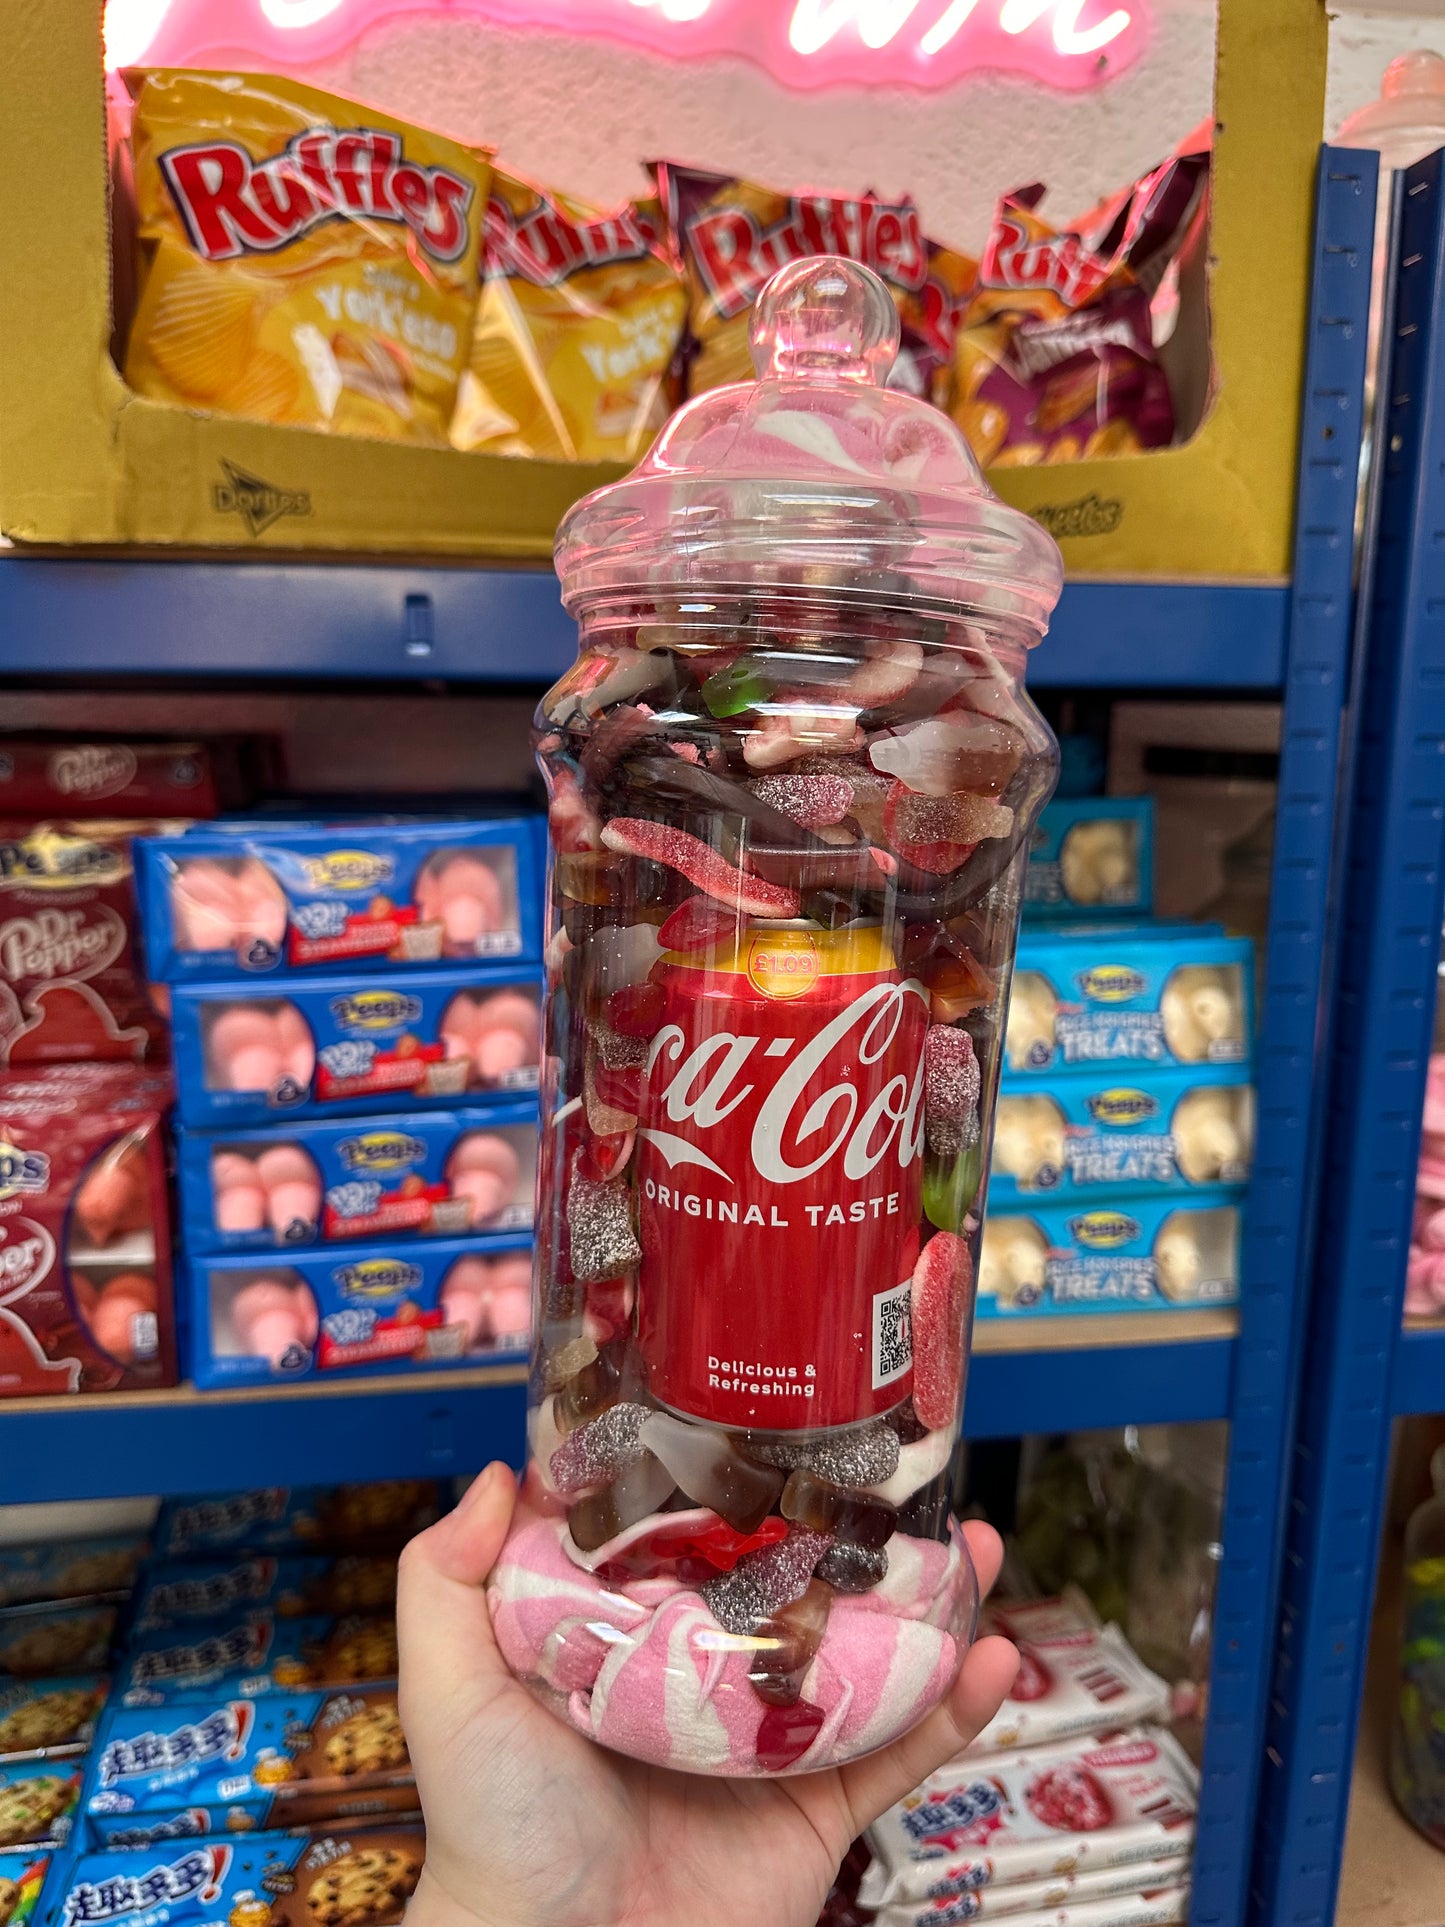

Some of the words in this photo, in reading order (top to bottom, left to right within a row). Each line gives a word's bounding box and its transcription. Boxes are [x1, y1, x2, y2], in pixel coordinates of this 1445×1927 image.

[160, 128, 475, 262] Ruffles
[37, 909, 86, 946] Dr
[0, 918, 117, 981] Pepper
[754, 953, 814, 973] £1.09
[1063, 1030, 1164, 1061] TREATS
[1072, 1153, 1173, 1183] TREATS
[645, 1178, 789, 1227] ORIGINAL
[805, 1192, 899, 1226] TASTE
[1053, 1274, 1154, 1300] TREATS
[708, 1355, 798, 1378] Delicious
[804, 1363, 816, 1377] &
[709, 1373, 815, 1397] Refreshing
